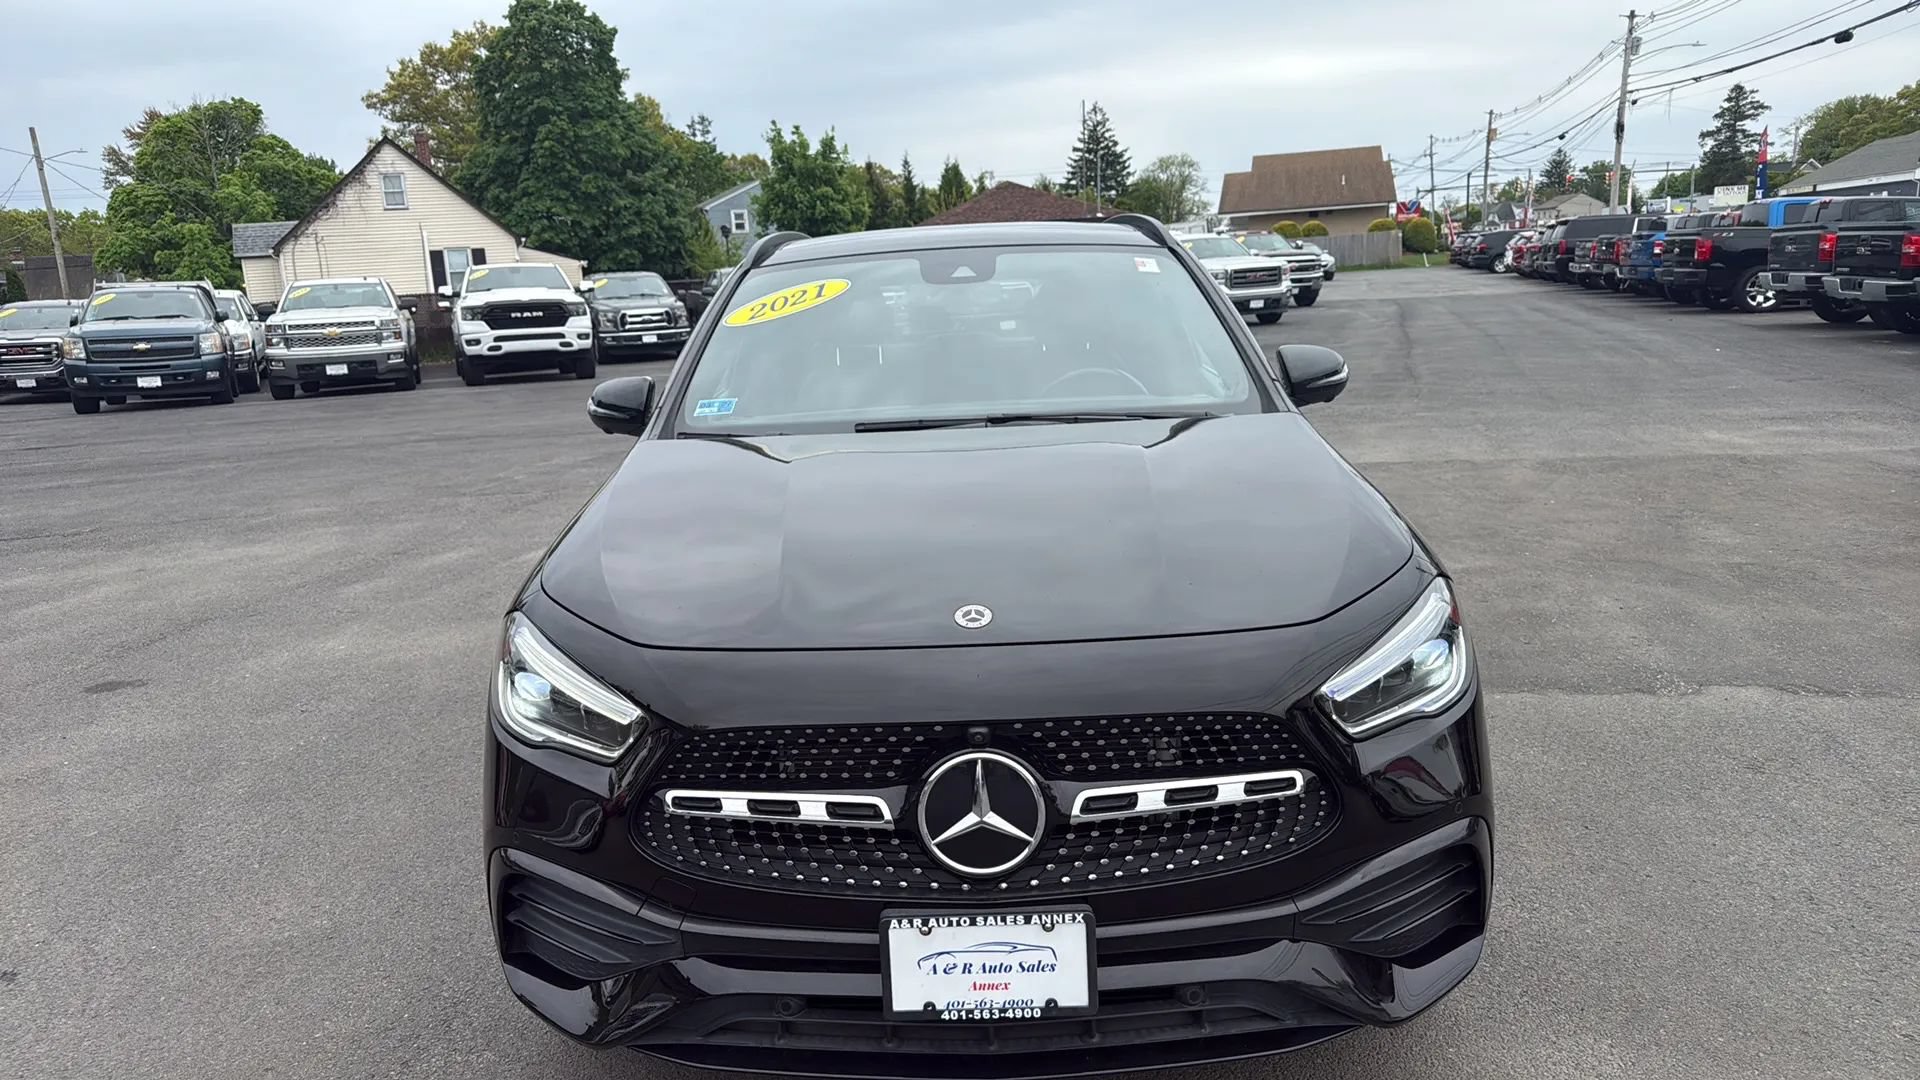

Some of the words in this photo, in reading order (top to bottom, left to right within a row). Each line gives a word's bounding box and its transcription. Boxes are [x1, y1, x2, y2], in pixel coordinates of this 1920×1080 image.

[748, 283, 827, 321] 2021
[889, 918, 922, 929] A&R
[927, 917, 970, 928] AUTO
[976, 915, 1025, 926] SALES
[1030, 913, 1084, 925] ANNEX
[927, 963, 938, 976] A
[943, 962, 958, 974] &
[961, 962, 973, 974] R
[976, 961, 1012, 974] Auto
[1016, 959, 1057, 973] Sales
[968, 981, 1011, 992] Annex
[941, 1008, 1041, 1020] 401-563-4900
